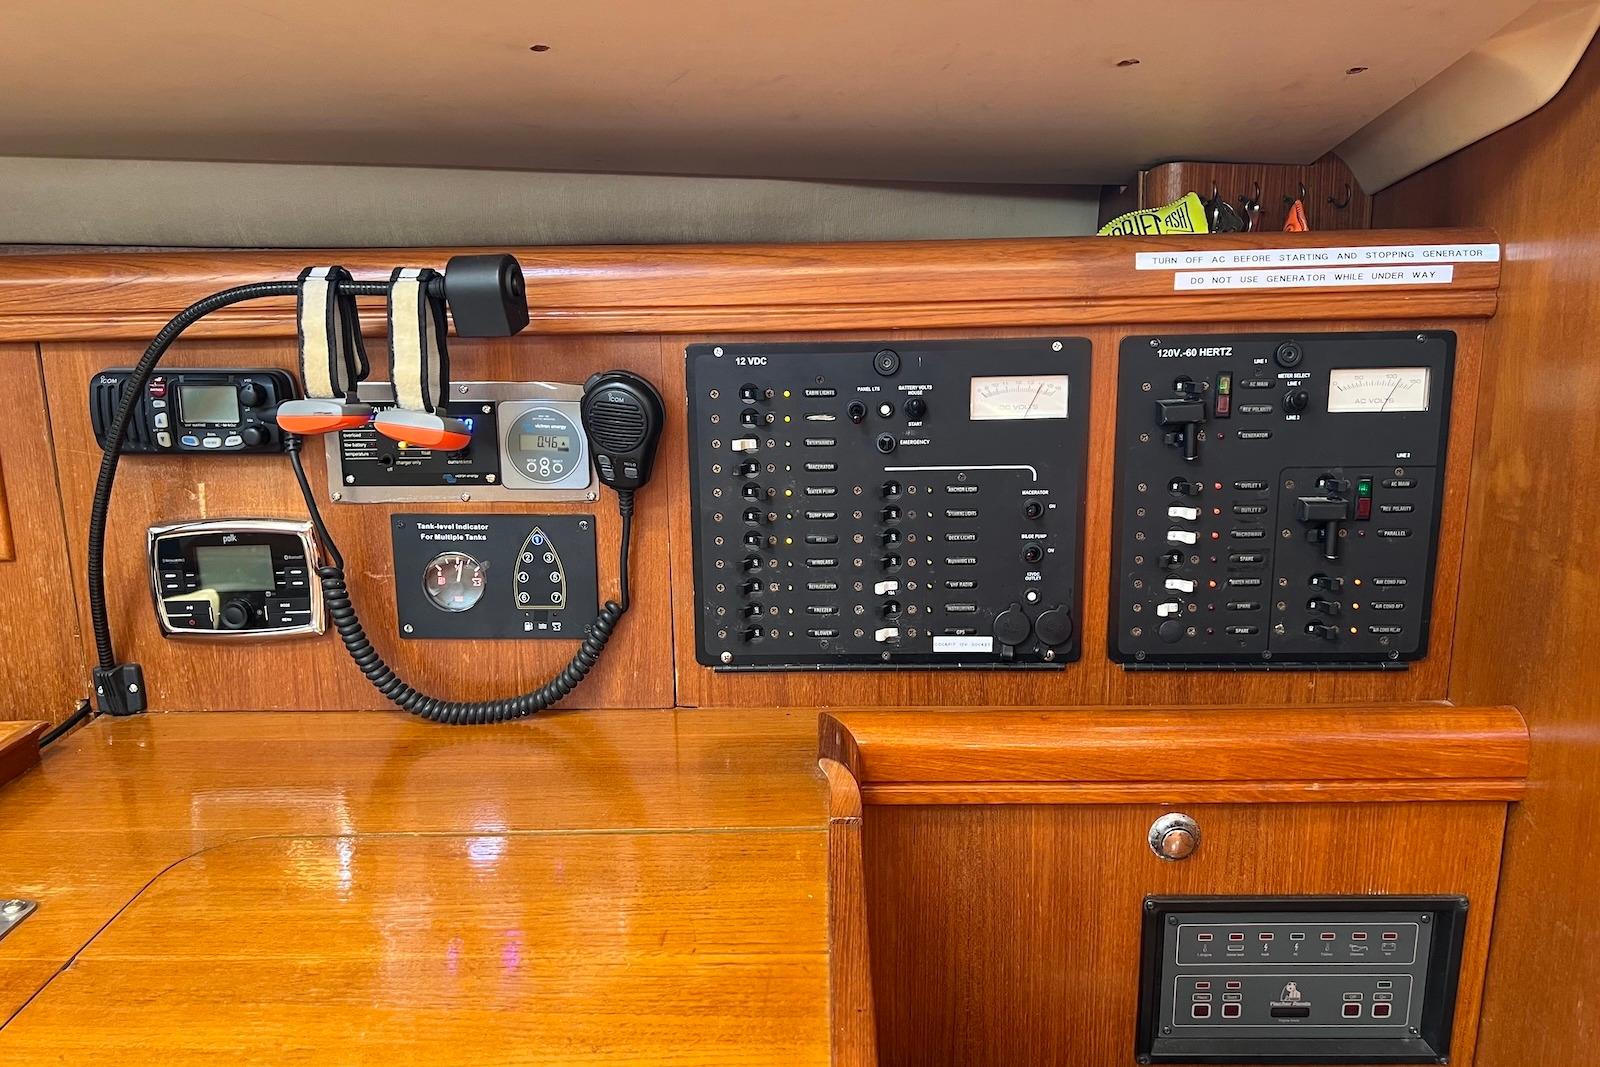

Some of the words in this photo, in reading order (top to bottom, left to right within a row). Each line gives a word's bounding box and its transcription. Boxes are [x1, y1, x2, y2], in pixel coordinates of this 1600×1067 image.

[1153, 257, 1178, 265] TURN
[1185, 256, 1203, 264] OFF
[1212, 255, 1226, 263] AC
[1233, 255, 1271, 263] BEFORE
[1279, 253, 1329, 262] STARTING
[1337, 252, 1358, 260] AND
[1366, 251, 1415, 259] STOPPING
[1422, 249, 1484, 258] GENERATOR
[1190, 277, 1204, 285] DO
[1212, 276, 1232, 284] NOT
[1240, 275, 1258, 283] USE
[1266, 274, 1326, 283] GENERATOR
[1334, 273, 1364, 281] WHILE
[1371, 272, 1404, 280] UNDER
[1412, 271, 1436, 279] WAY
[1199, 347, 1233, 357] HERTZ
[735, 357, 746, 366] 12
[747, 356, 768, 366] VDC
[434, 533, 464, 541] Multiple
